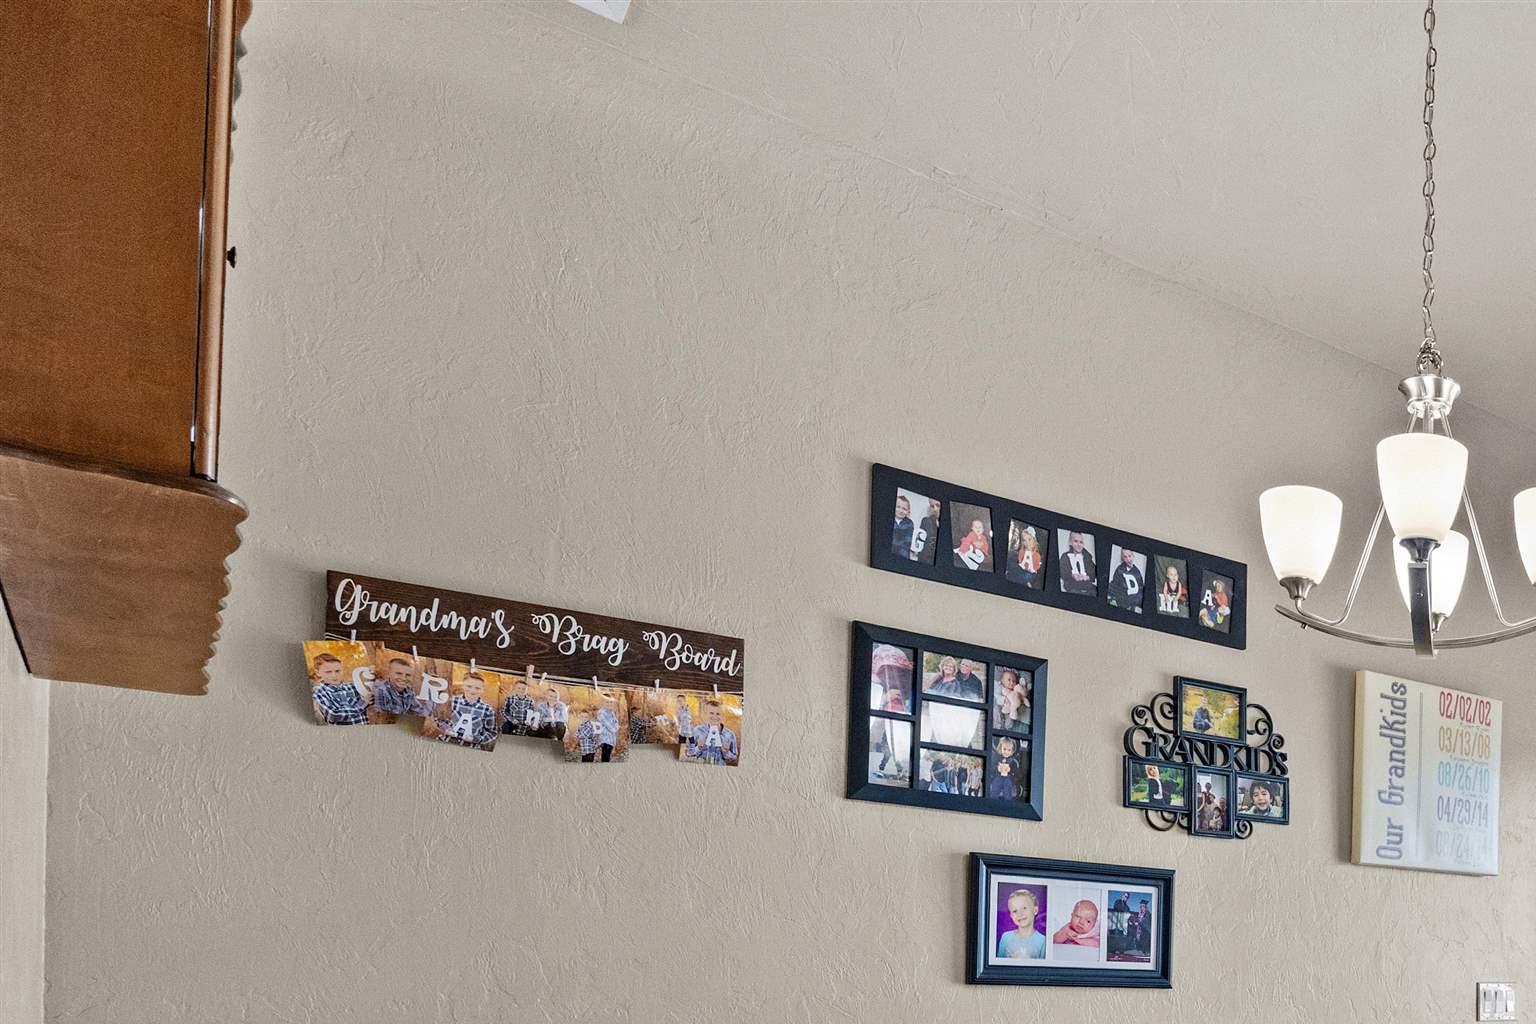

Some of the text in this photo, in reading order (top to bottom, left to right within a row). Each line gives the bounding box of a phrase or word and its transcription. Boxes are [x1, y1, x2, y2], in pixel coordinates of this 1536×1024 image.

[335, 578, 740, 677] Grandma's Brag Board
[1439, 691, 1491, 727] 02/02/02
[1124, 725, 1289, 776] GRANDKIDS
[1438, 726, 1490, 760] 03/13/08
[1438, 761, 1489, 793] 08/26/10
[1376, 816, 1404, 860] Our
